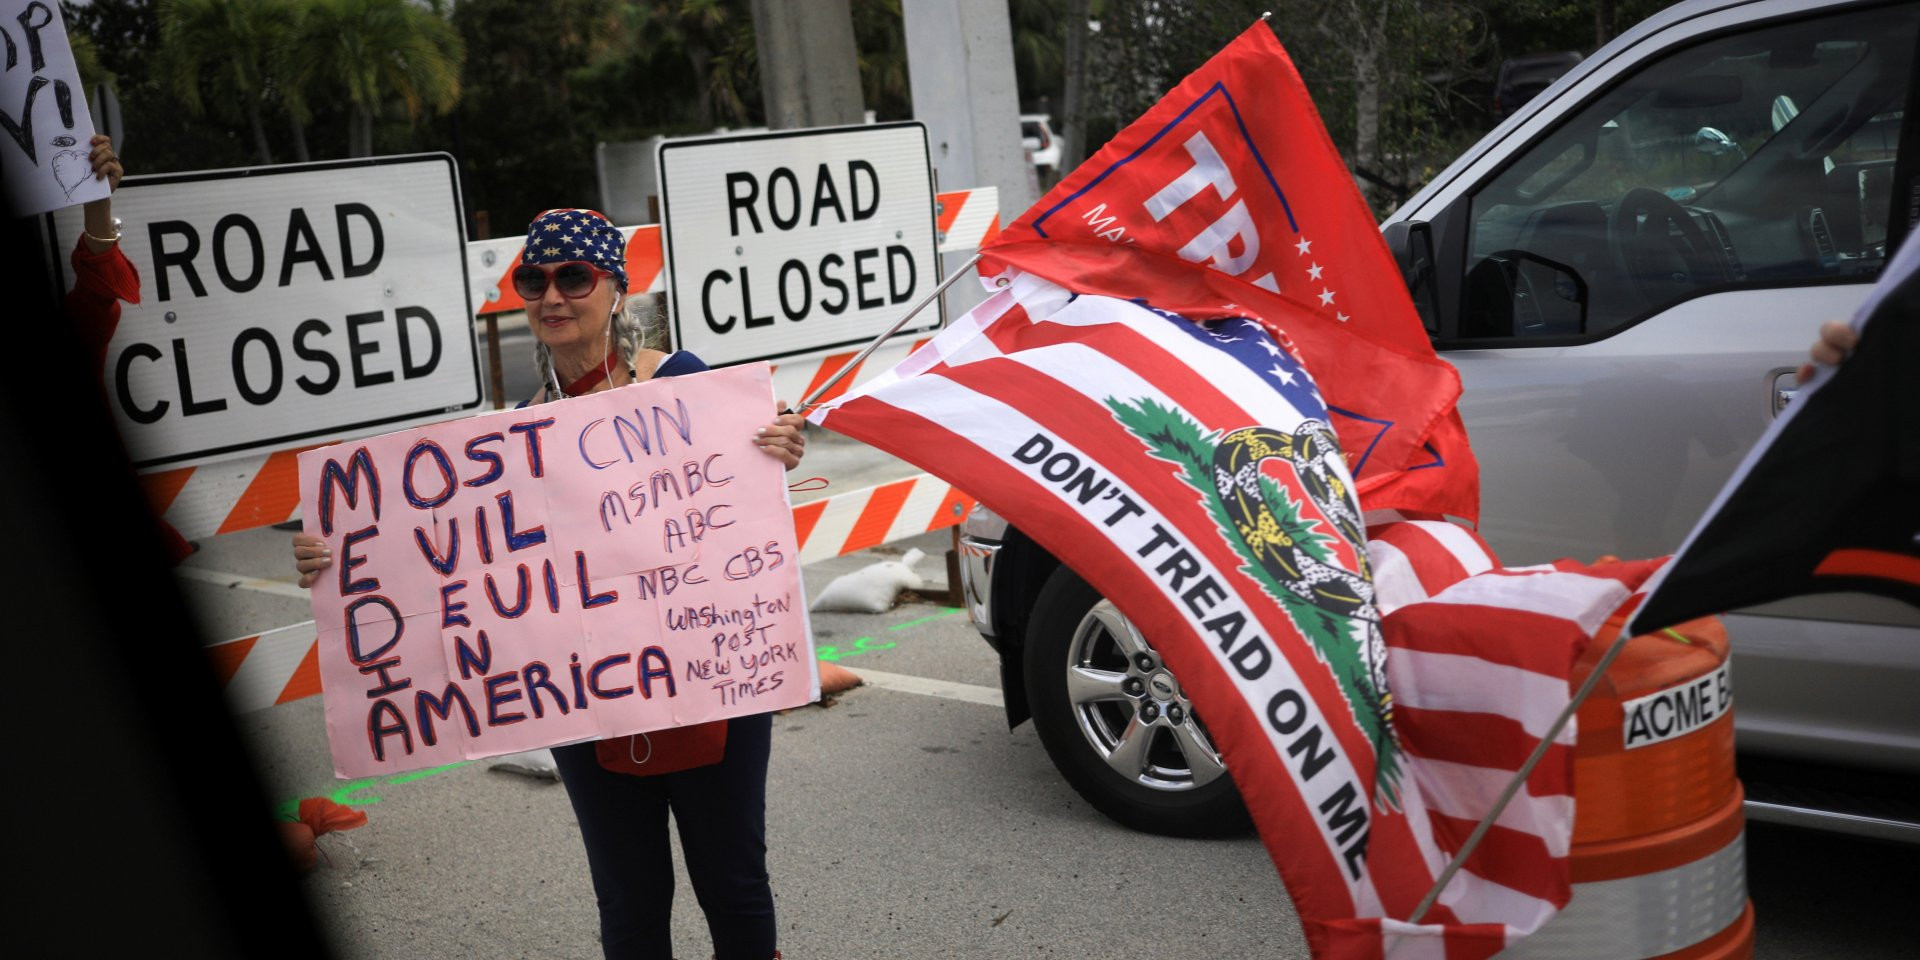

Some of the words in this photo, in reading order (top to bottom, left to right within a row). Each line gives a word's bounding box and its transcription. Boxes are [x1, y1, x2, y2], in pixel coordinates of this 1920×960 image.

[726, 160, 880, 236] ROAD
[1082, 203, 1137, 243] MA
[1143, 130, 1281, 294] TR
[147, 203, 385, 302] ROAD
[702, 245, 917, 334] CLOSED
[115, 306, 443, 425] CLOSED
[578, 399, 692, 469] CNN
[664, 504, 736, 553] ABC
[638, 564, 709, 601] NBC
[723, 541, 785, 581] CBS
[712, 624, 775, 657] POST
[1011, 433, 1144, 534] DON'T
[1136, 523, 1273, 681] TREAD
[1266, 688, 1337, 783] ON
[687, 659, 732, 682] NEW
[1627, 680, 1713, 745] ACME
